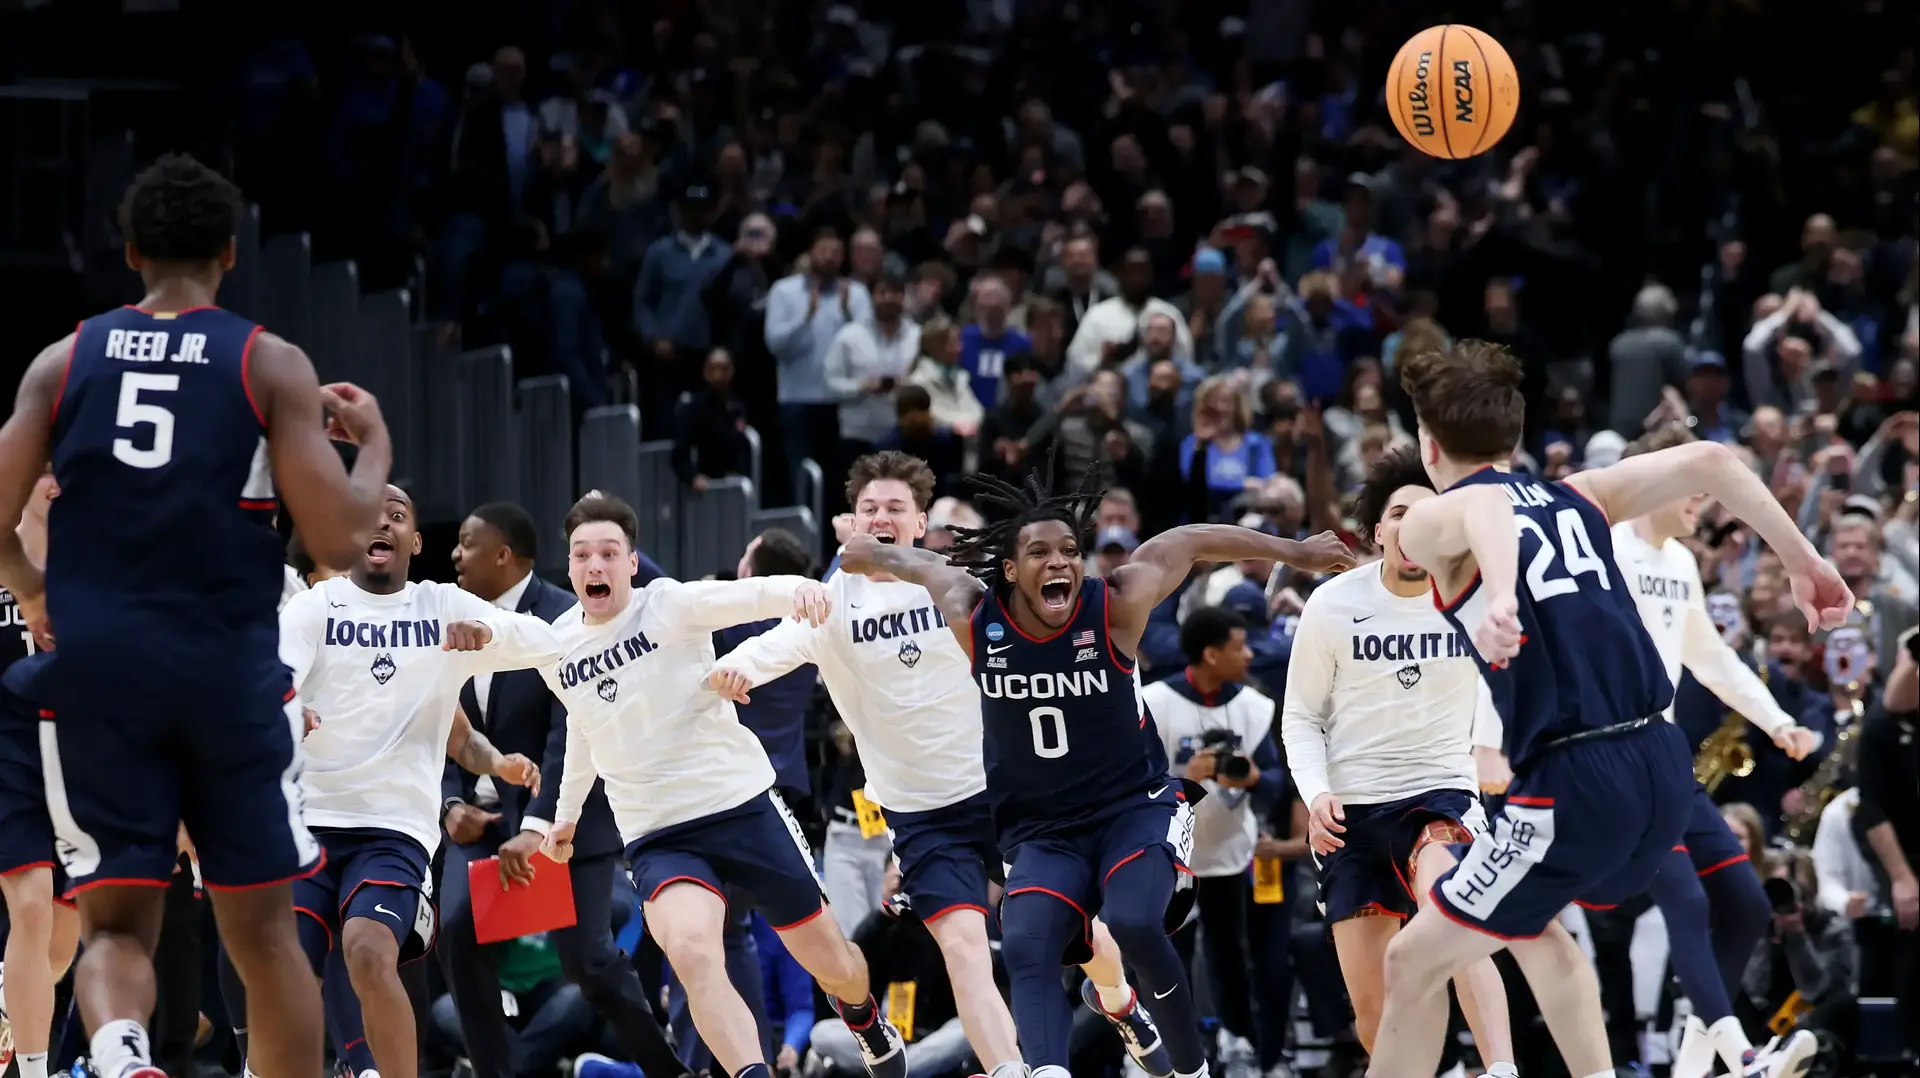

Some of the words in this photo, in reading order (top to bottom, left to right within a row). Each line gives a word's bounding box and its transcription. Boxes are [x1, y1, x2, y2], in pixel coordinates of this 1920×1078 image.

[1409, 52, 1434, 136] Wilson
[1453, 60, 1473, 123] NCAA
[105, 329, 170, 362] REED
[170, 333, 209, 364] JR.
[112, 371, 180, 469] 5
[1514, 508, 1612, 603] 24
[21, 631, 36, 657] 1
[325, 617, 387, 648] LOCK
[390, 620, 412, 648] IT
[852, 612, 909, 643] LOCK
[909, 606, 930, 634] IT
[933, 605, 948, 628] I
[559, 653, 605, 690] LOCK
[603, 642, 624, 671] IT
[623, 630, 659, 661] IN.
[1352, 634, 1415, 661] LOCK
[1420, 633, 1442, 659] IT
[980, 669, 1109, 700] UCONN
[1028, 706, 1069, 759] 0
